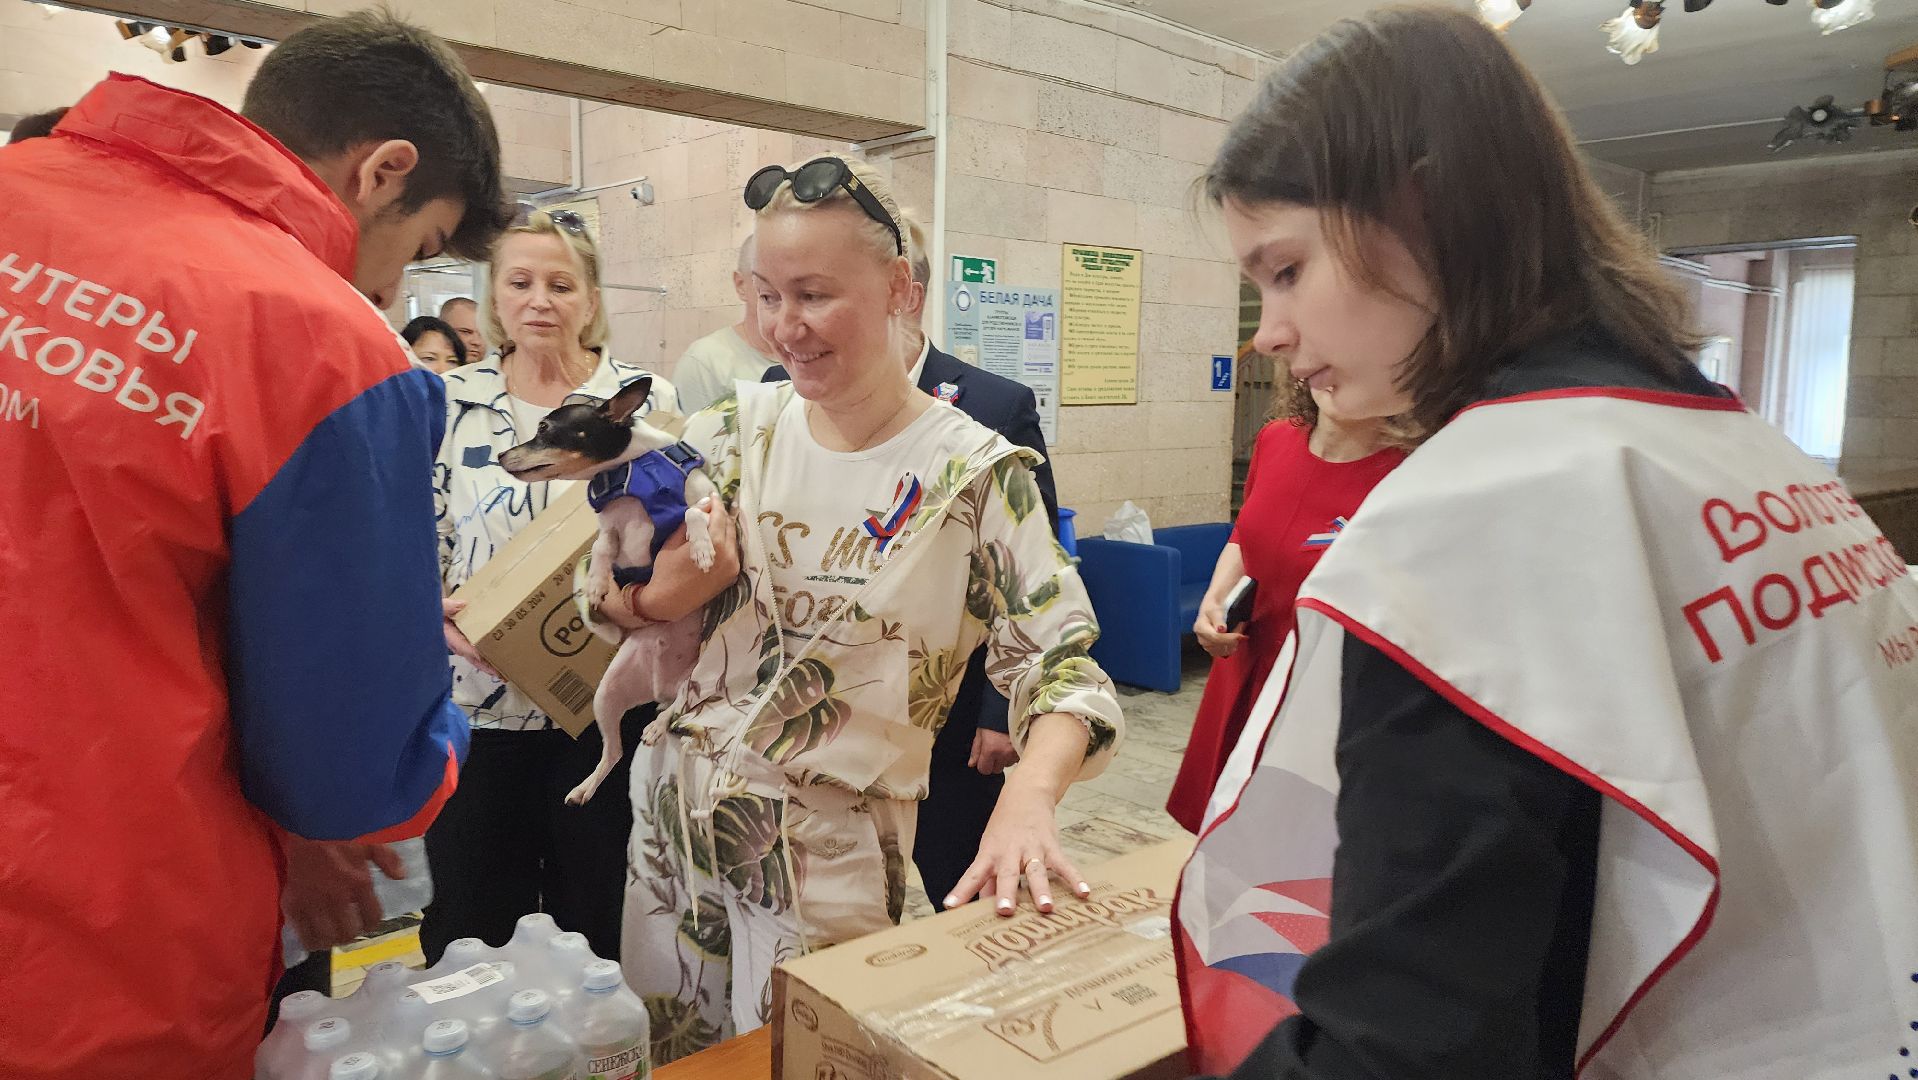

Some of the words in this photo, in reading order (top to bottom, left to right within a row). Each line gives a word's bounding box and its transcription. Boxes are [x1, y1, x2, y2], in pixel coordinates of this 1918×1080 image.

[980, 291, 1019, 305] БЕЛАЯ
[1023, 293, 1053, 308] ДАЧА
[0, 306, 205, 440] КОВЬЯ
